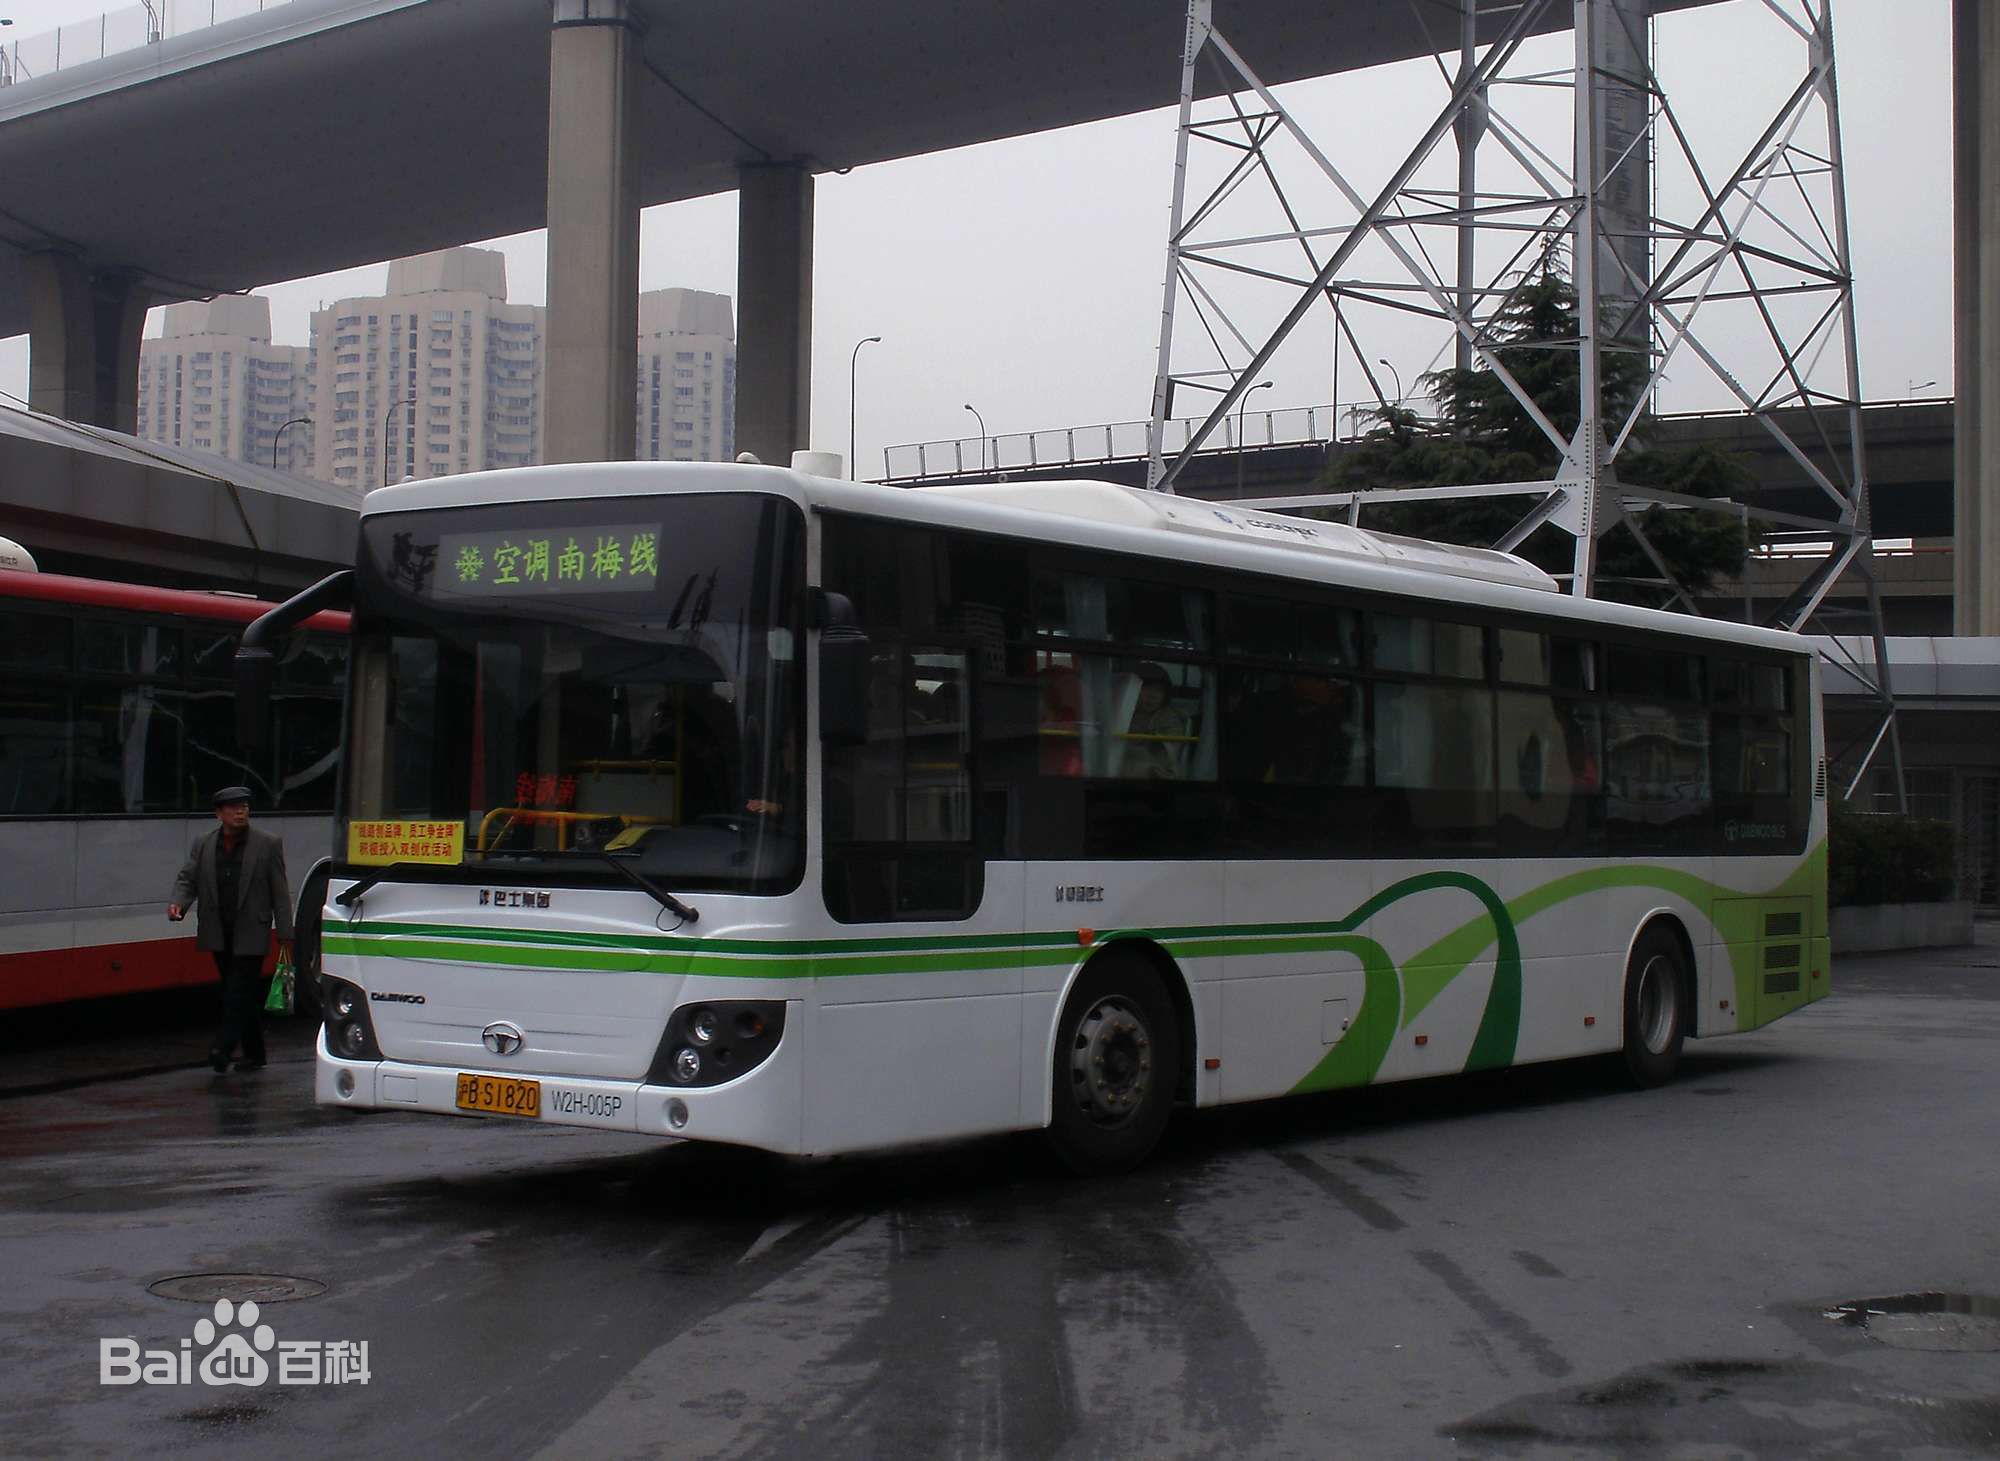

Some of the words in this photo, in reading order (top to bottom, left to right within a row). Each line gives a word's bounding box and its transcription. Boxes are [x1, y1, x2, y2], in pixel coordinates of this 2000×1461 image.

[492, 533, 658, 584] 空调南梅线
[551, 1089, 622, 1117] W2H-005P
